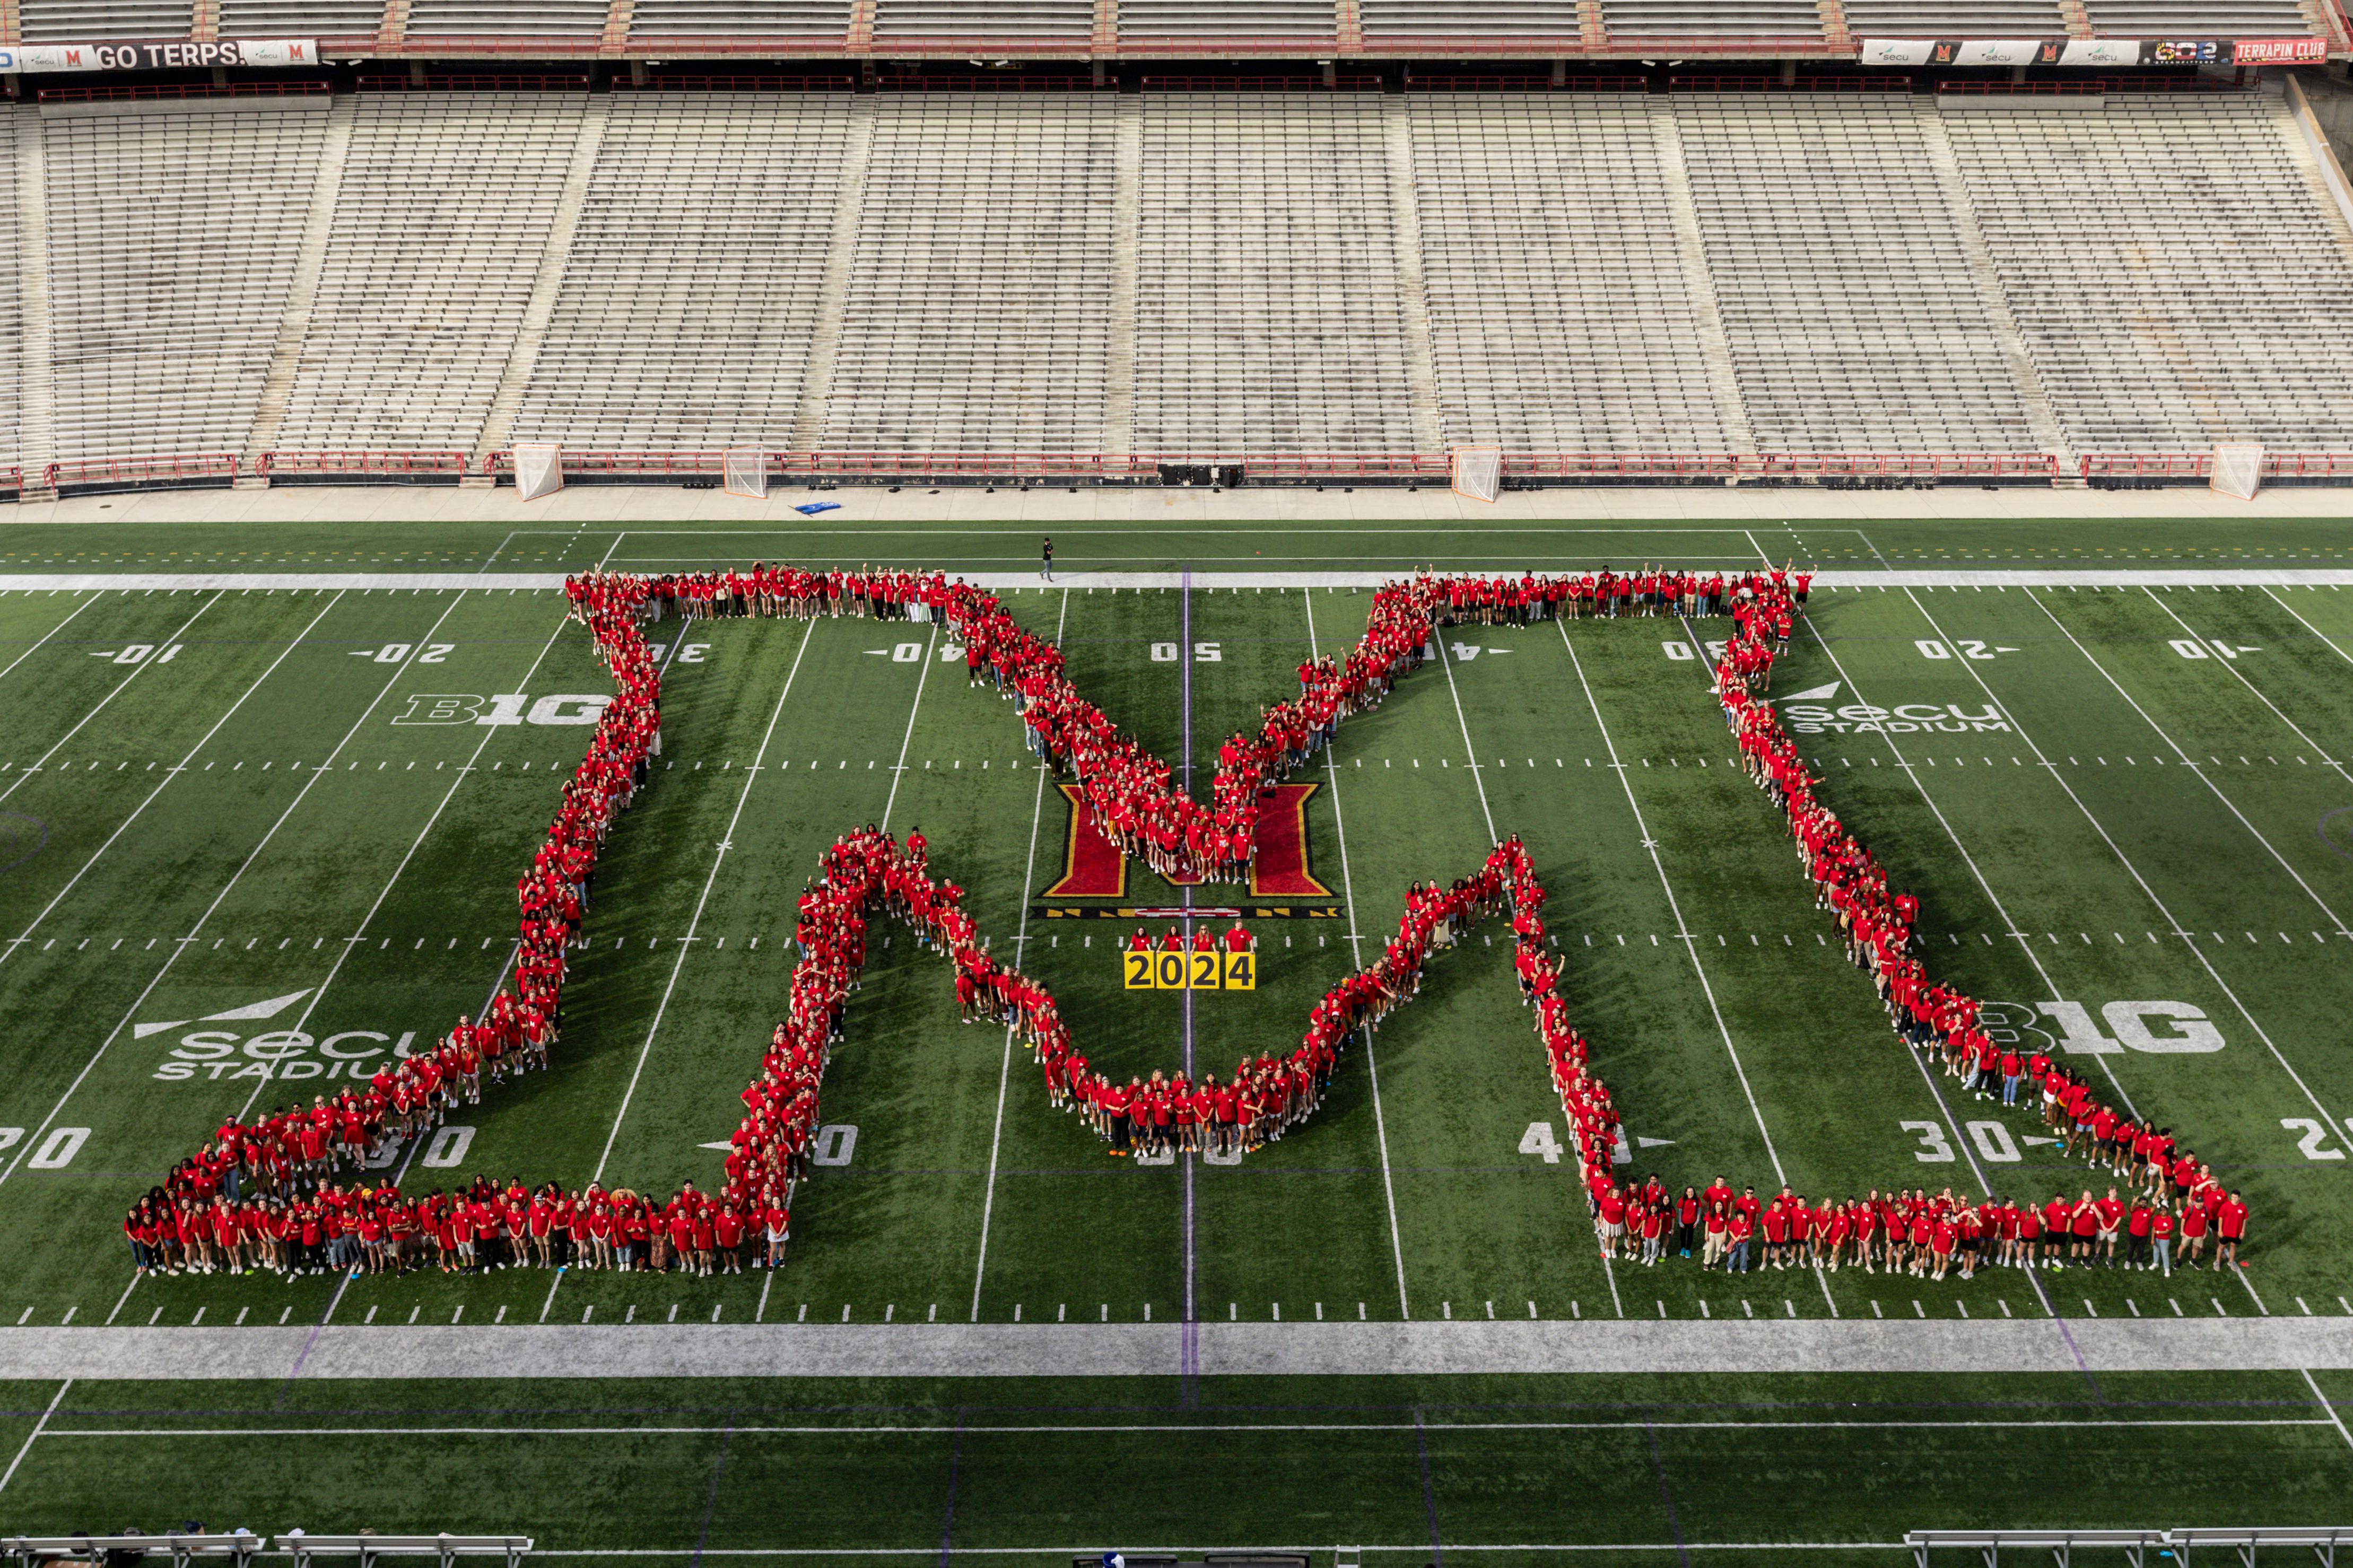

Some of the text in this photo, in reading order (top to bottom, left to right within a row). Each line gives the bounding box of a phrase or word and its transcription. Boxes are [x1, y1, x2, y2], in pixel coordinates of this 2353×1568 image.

[66, 50, 82, 66] M
[96, 42, 246, 69] GO TERPS!
[289, 45, 304, 60] M
[1936, 45, 1951, 62] M
[2042, 45, 2057, 62] M
[2238, 42, 2325, 58] TERRAPIN CLUB
[113, 644, 184, 663] 10
[373, 644, 456, 663] 20
[892, 643, 966, 662] 40
[1151, 643, 1222, 662] 50
[1914, 640, 1995, 660] 20
[2167, 640, 2237, 659] 10
[1784, 704, 2001, 721] secu
[1793, 722, 2012, 733] STADIUM
[1128, 954, 1253, 986] 2024
[169, 1031, 455, 1061] secu
[152, 1061, 409, 1080] STADIU
[1899, 1120, 2023, 1162] 30
[2280, 1118, 2353, 1160] 2
